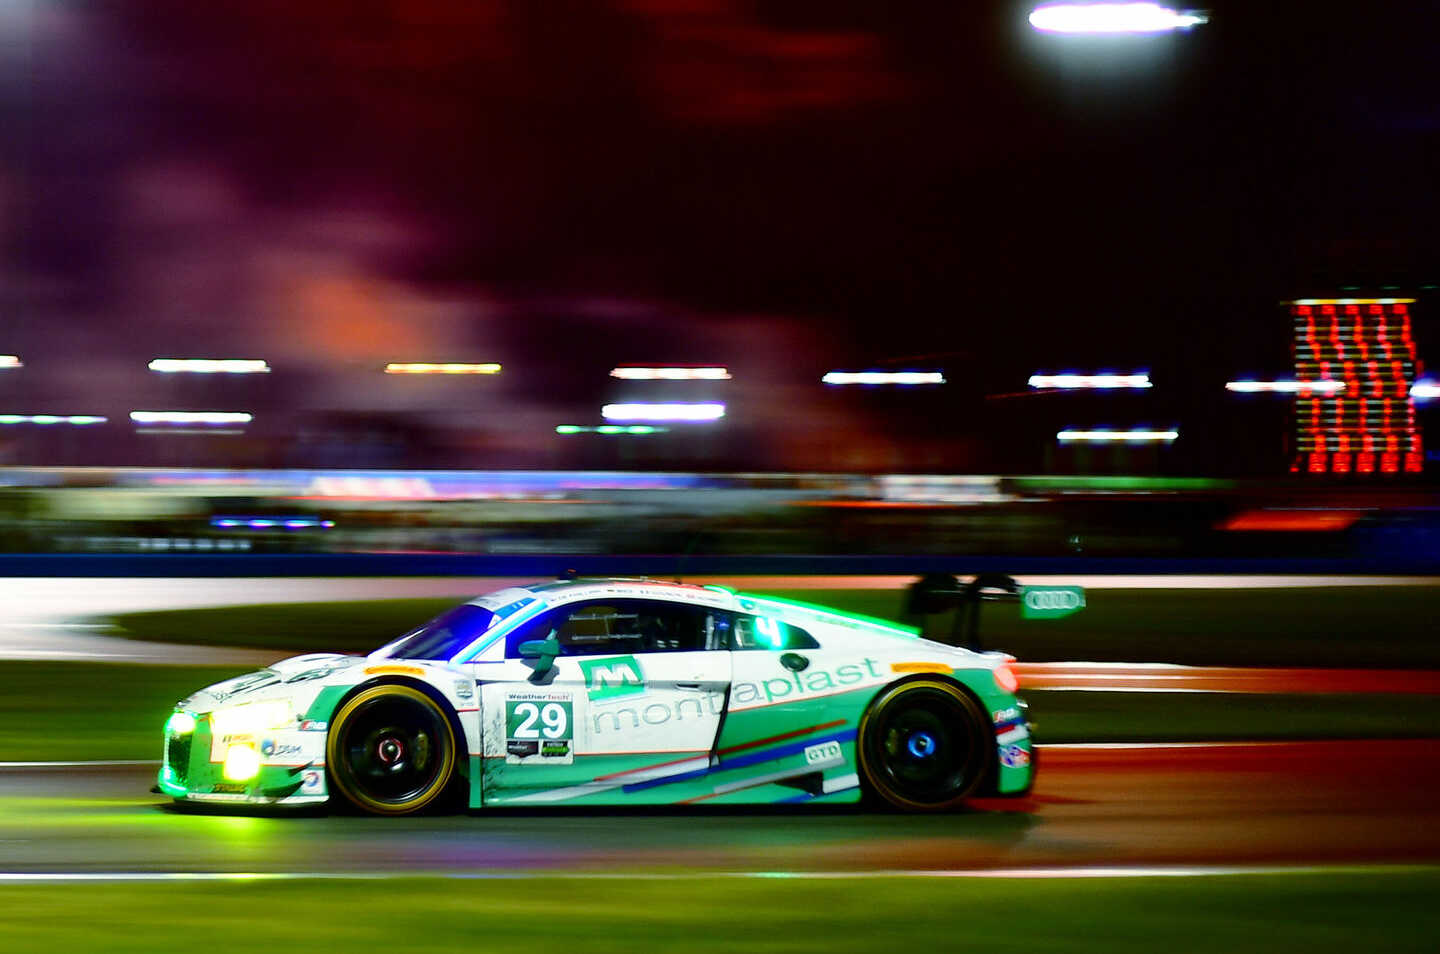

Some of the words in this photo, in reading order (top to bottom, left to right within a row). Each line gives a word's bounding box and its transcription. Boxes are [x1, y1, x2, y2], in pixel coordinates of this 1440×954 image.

[754, 616, 782, 647] 4
[591, 656, 884, 734] montaplast
[513, 702, 567, 739] 29
[808, 745, 838, 761] GTD
